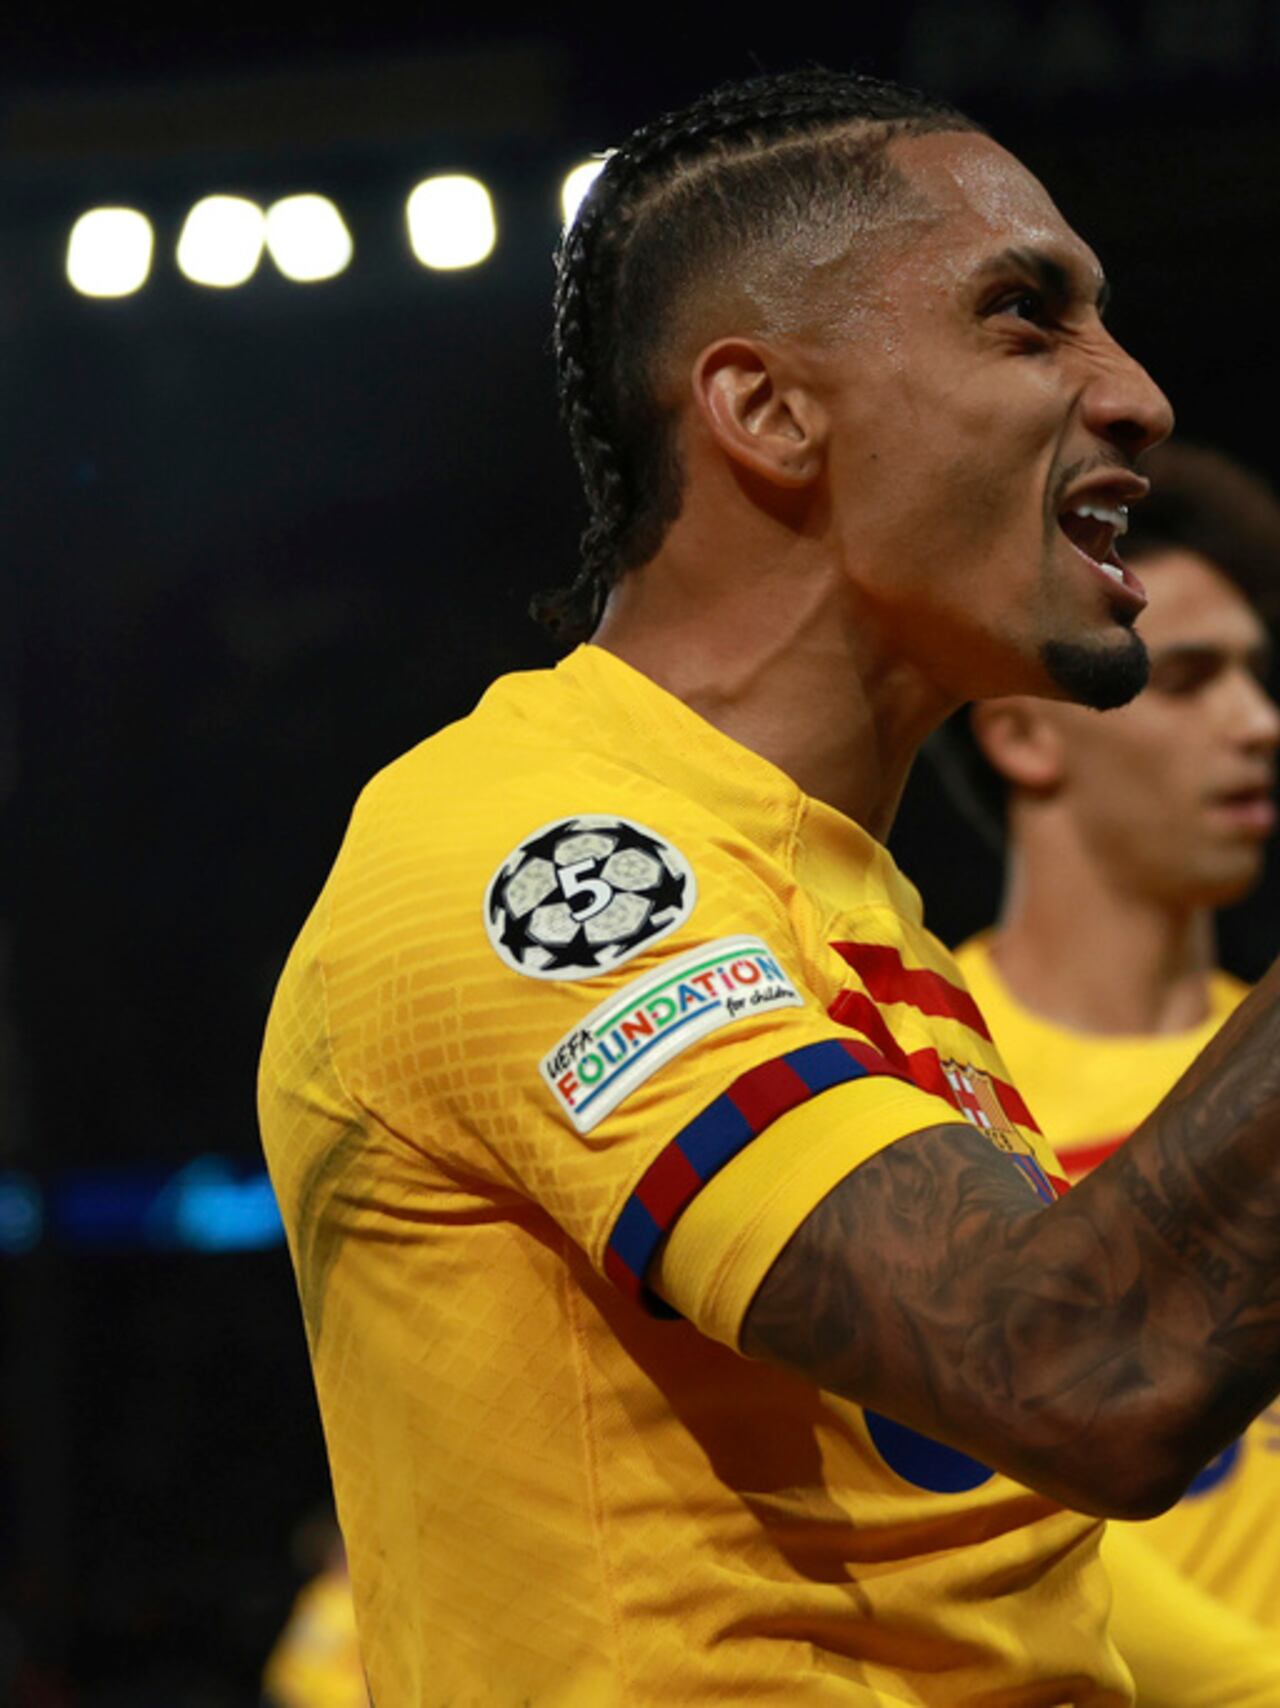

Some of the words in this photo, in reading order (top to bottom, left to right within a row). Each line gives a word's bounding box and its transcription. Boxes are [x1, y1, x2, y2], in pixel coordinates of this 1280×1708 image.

[557, 856, 614, 923] 5
[725, 996, 746, 1018] for
[546, 1028, 594, 1079] UEFA
